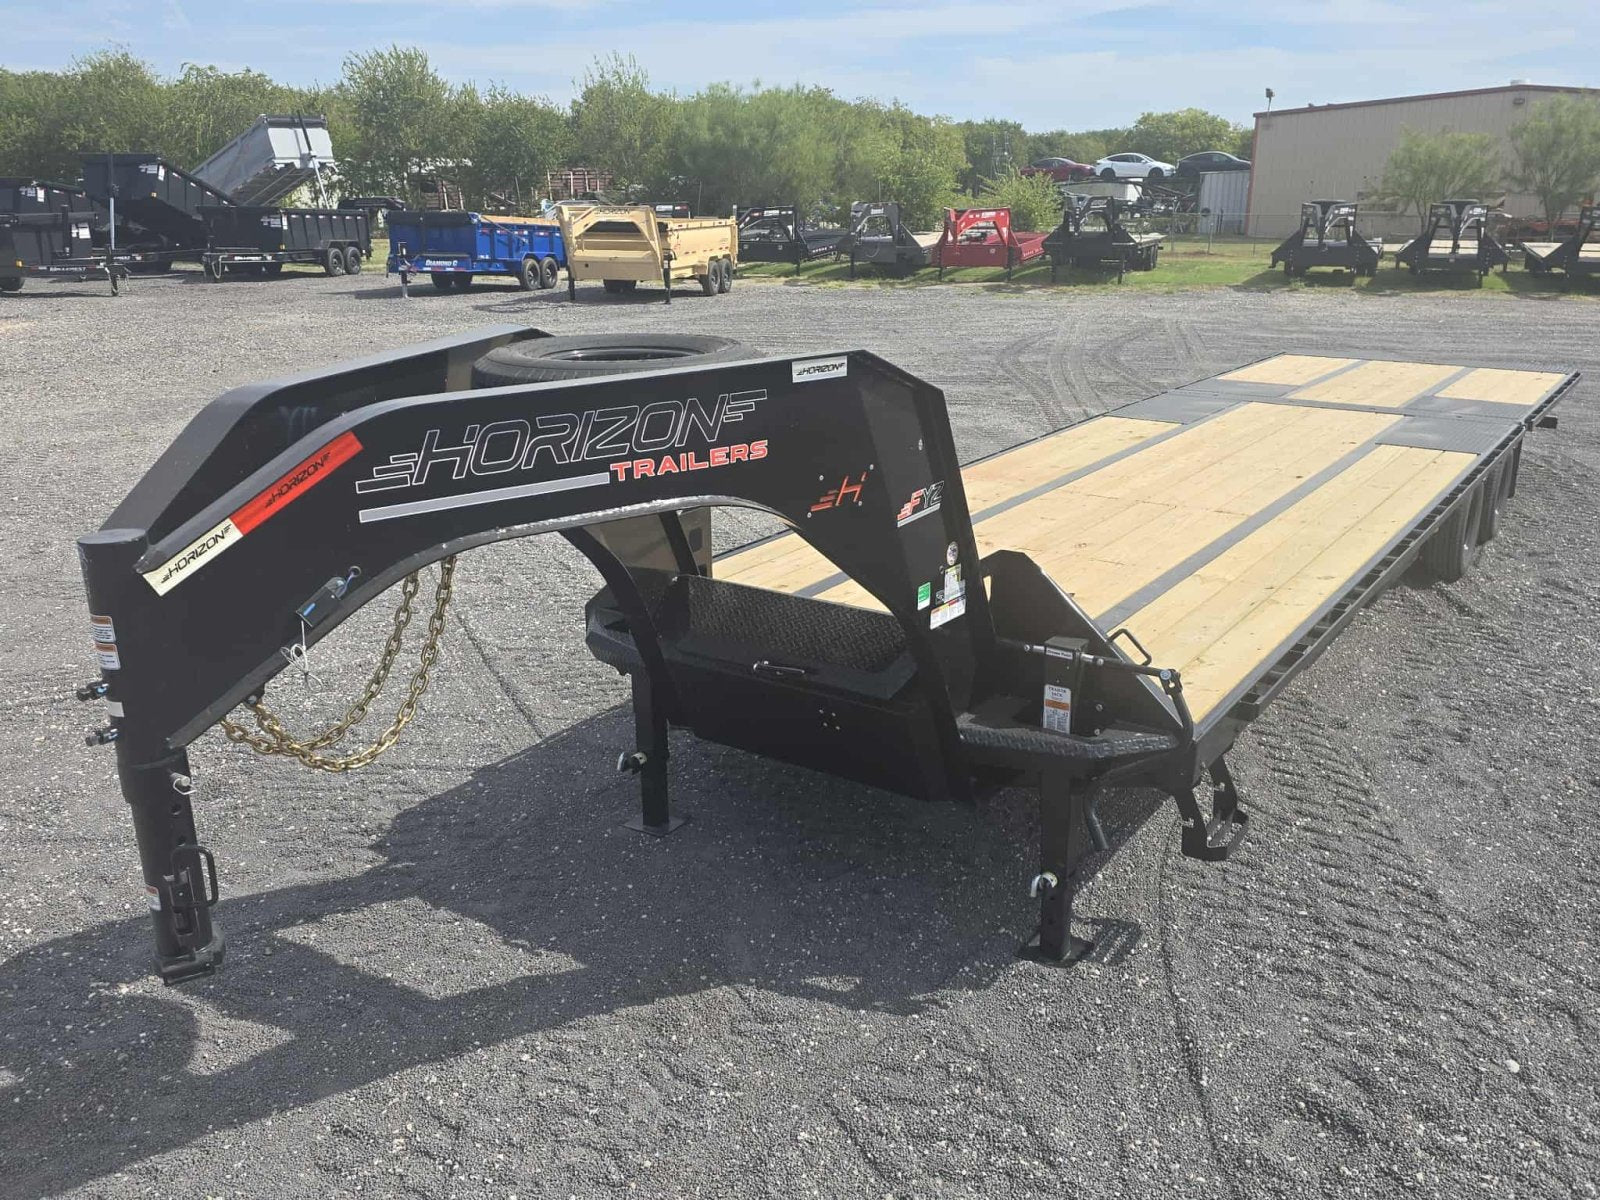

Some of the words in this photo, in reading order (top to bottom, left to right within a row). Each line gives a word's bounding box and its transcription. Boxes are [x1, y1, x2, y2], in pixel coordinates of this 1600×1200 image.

[797, 363, 845, 376] HORIZON
[385, 391, 750, 488] HORIZON
[609, 440, 769, 481] TRAILERS
[266, 454, 330, 507] HORIZON
[162, 526, 231, 582] HORIZON
